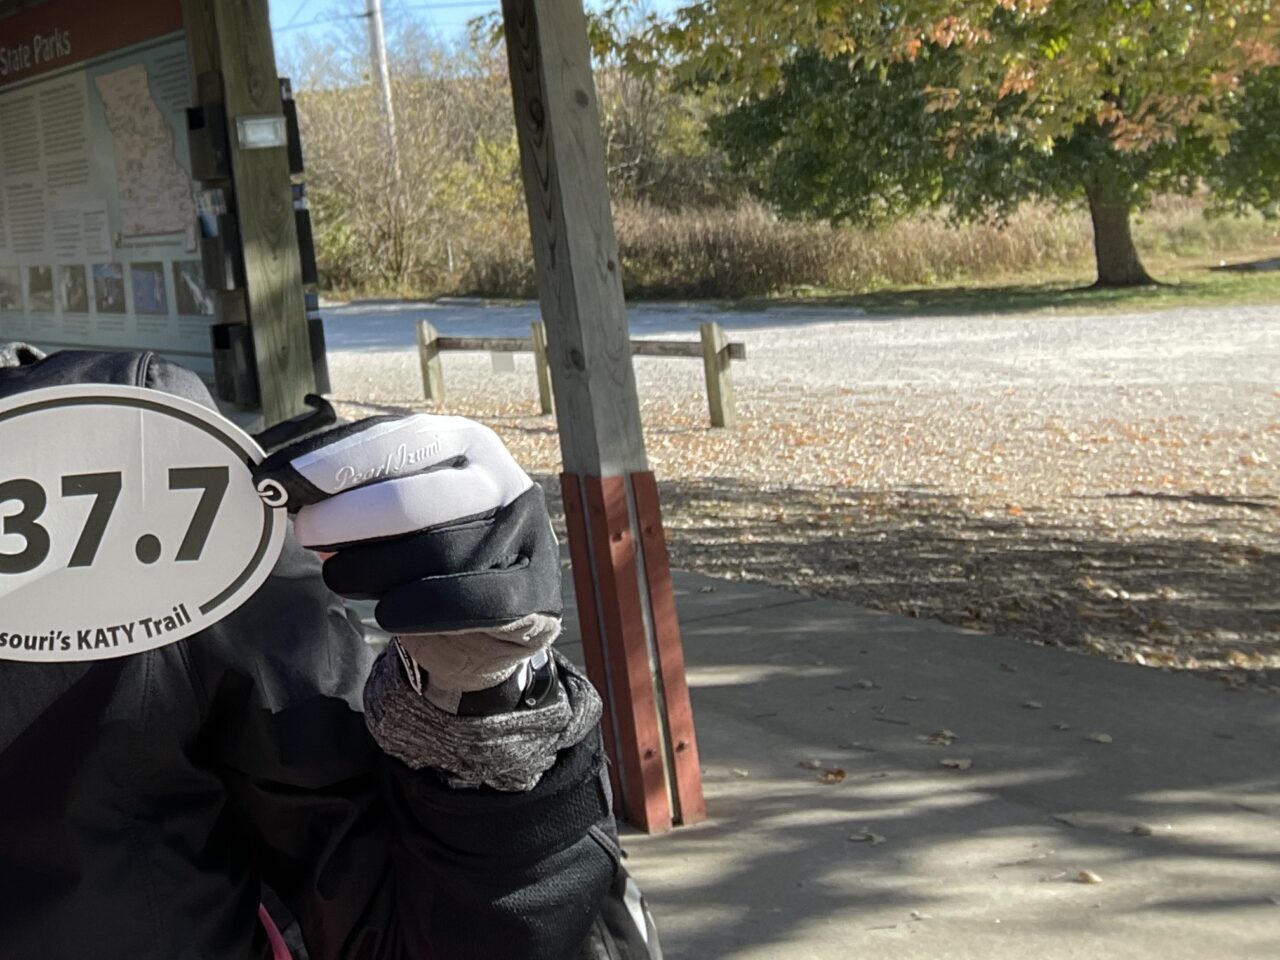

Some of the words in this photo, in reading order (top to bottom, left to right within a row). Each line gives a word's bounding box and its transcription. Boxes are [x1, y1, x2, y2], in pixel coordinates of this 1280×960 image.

[0, 44, 31, 76] State
[33, 27, 71, 65] Parks
[333, 452, 393, 490] Pearl
[77, 620, 134, 650] KATY
[139, 603, 192, 637] Trail
